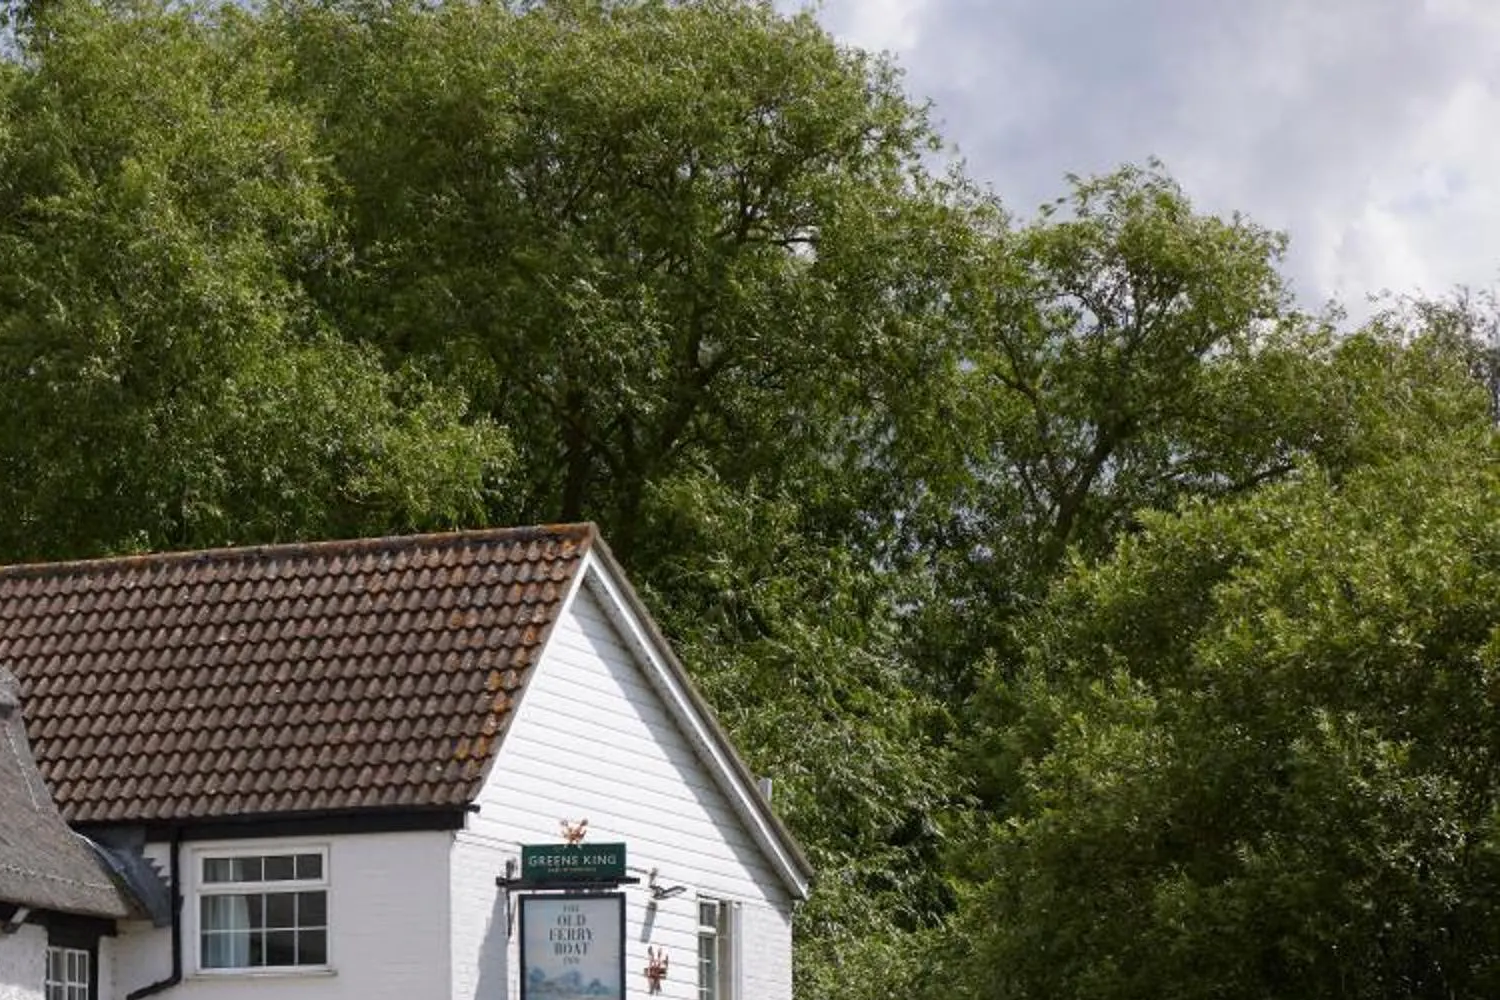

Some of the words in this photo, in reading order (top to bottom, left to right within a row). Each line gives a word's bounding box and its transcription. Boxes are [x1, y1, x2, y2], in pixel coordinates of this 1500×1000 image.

[583, 855, 617, 865] KING
[557, 914, 586, 926] OLD
[549, 928, 594, 941] FERRY
[554, 943, 589, 955] BOAT
